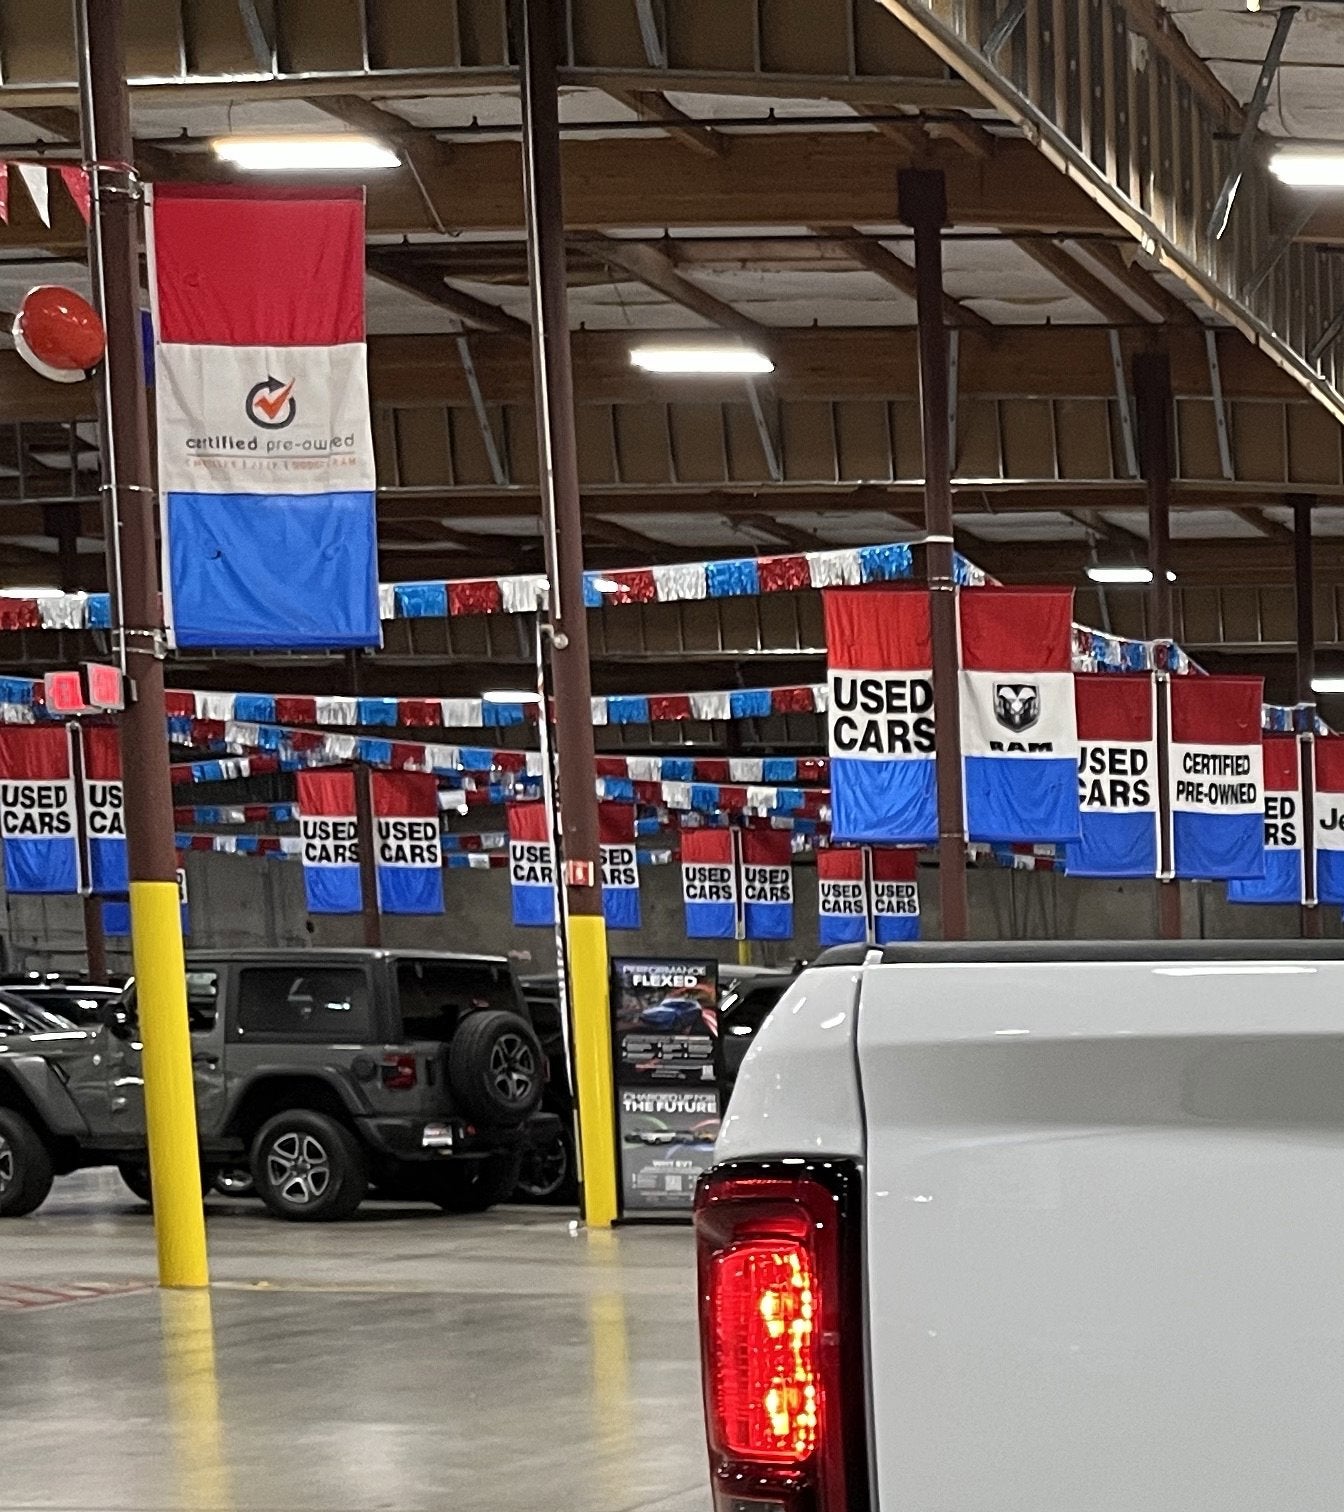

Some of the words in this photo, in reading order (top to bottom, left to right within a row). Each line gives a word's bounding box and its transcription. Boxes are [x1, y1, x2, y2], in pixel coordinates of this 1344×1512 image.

[833, 676, 934, 715] USED
[833, 716, 936, 754] CARS
[989, 741, 1054, 752] RAM
[1183, 752, 1251, 776] CERTIFIED
[2, 784, 68, 809] USED
[89, 784, 122, 809] US
[1176, 780, 1257, 805] PRE-OWNED
[1264, 797, 1296, 820] ED
[3, 810, 71, 834] CARS
[89, 810, 124, 834] CA
[303, 821, 359, 841] USED
[378, 821, 437, 841] USED
[1264, 822, 1297, 846] RS
[304, 843, 359, 863] CARS
[380, 843, 438, 863] CARS
[512, 845, 552, 863] USE
[600, 847, 633, 866] SED
[513, 864, 552, 883] CAR
[600, 868, 636, 885] RS
[685, 867, 731, 883] USED
[745, 868, 789, 884] USED
[686, 884, 732, 900] CARS
[745, 885, 791, 901] CARS
[821, 884, 862, 898] USED
[875, 884, 915, 898] USED
[822, 899, 864, 913] CARS
[875, 900, 917, 913] CARS
[632, 974, 698, 988] FLEXED
[623, 1101, 654, 1112] THE
[657, 1101, 717, 1113] FUTURE
